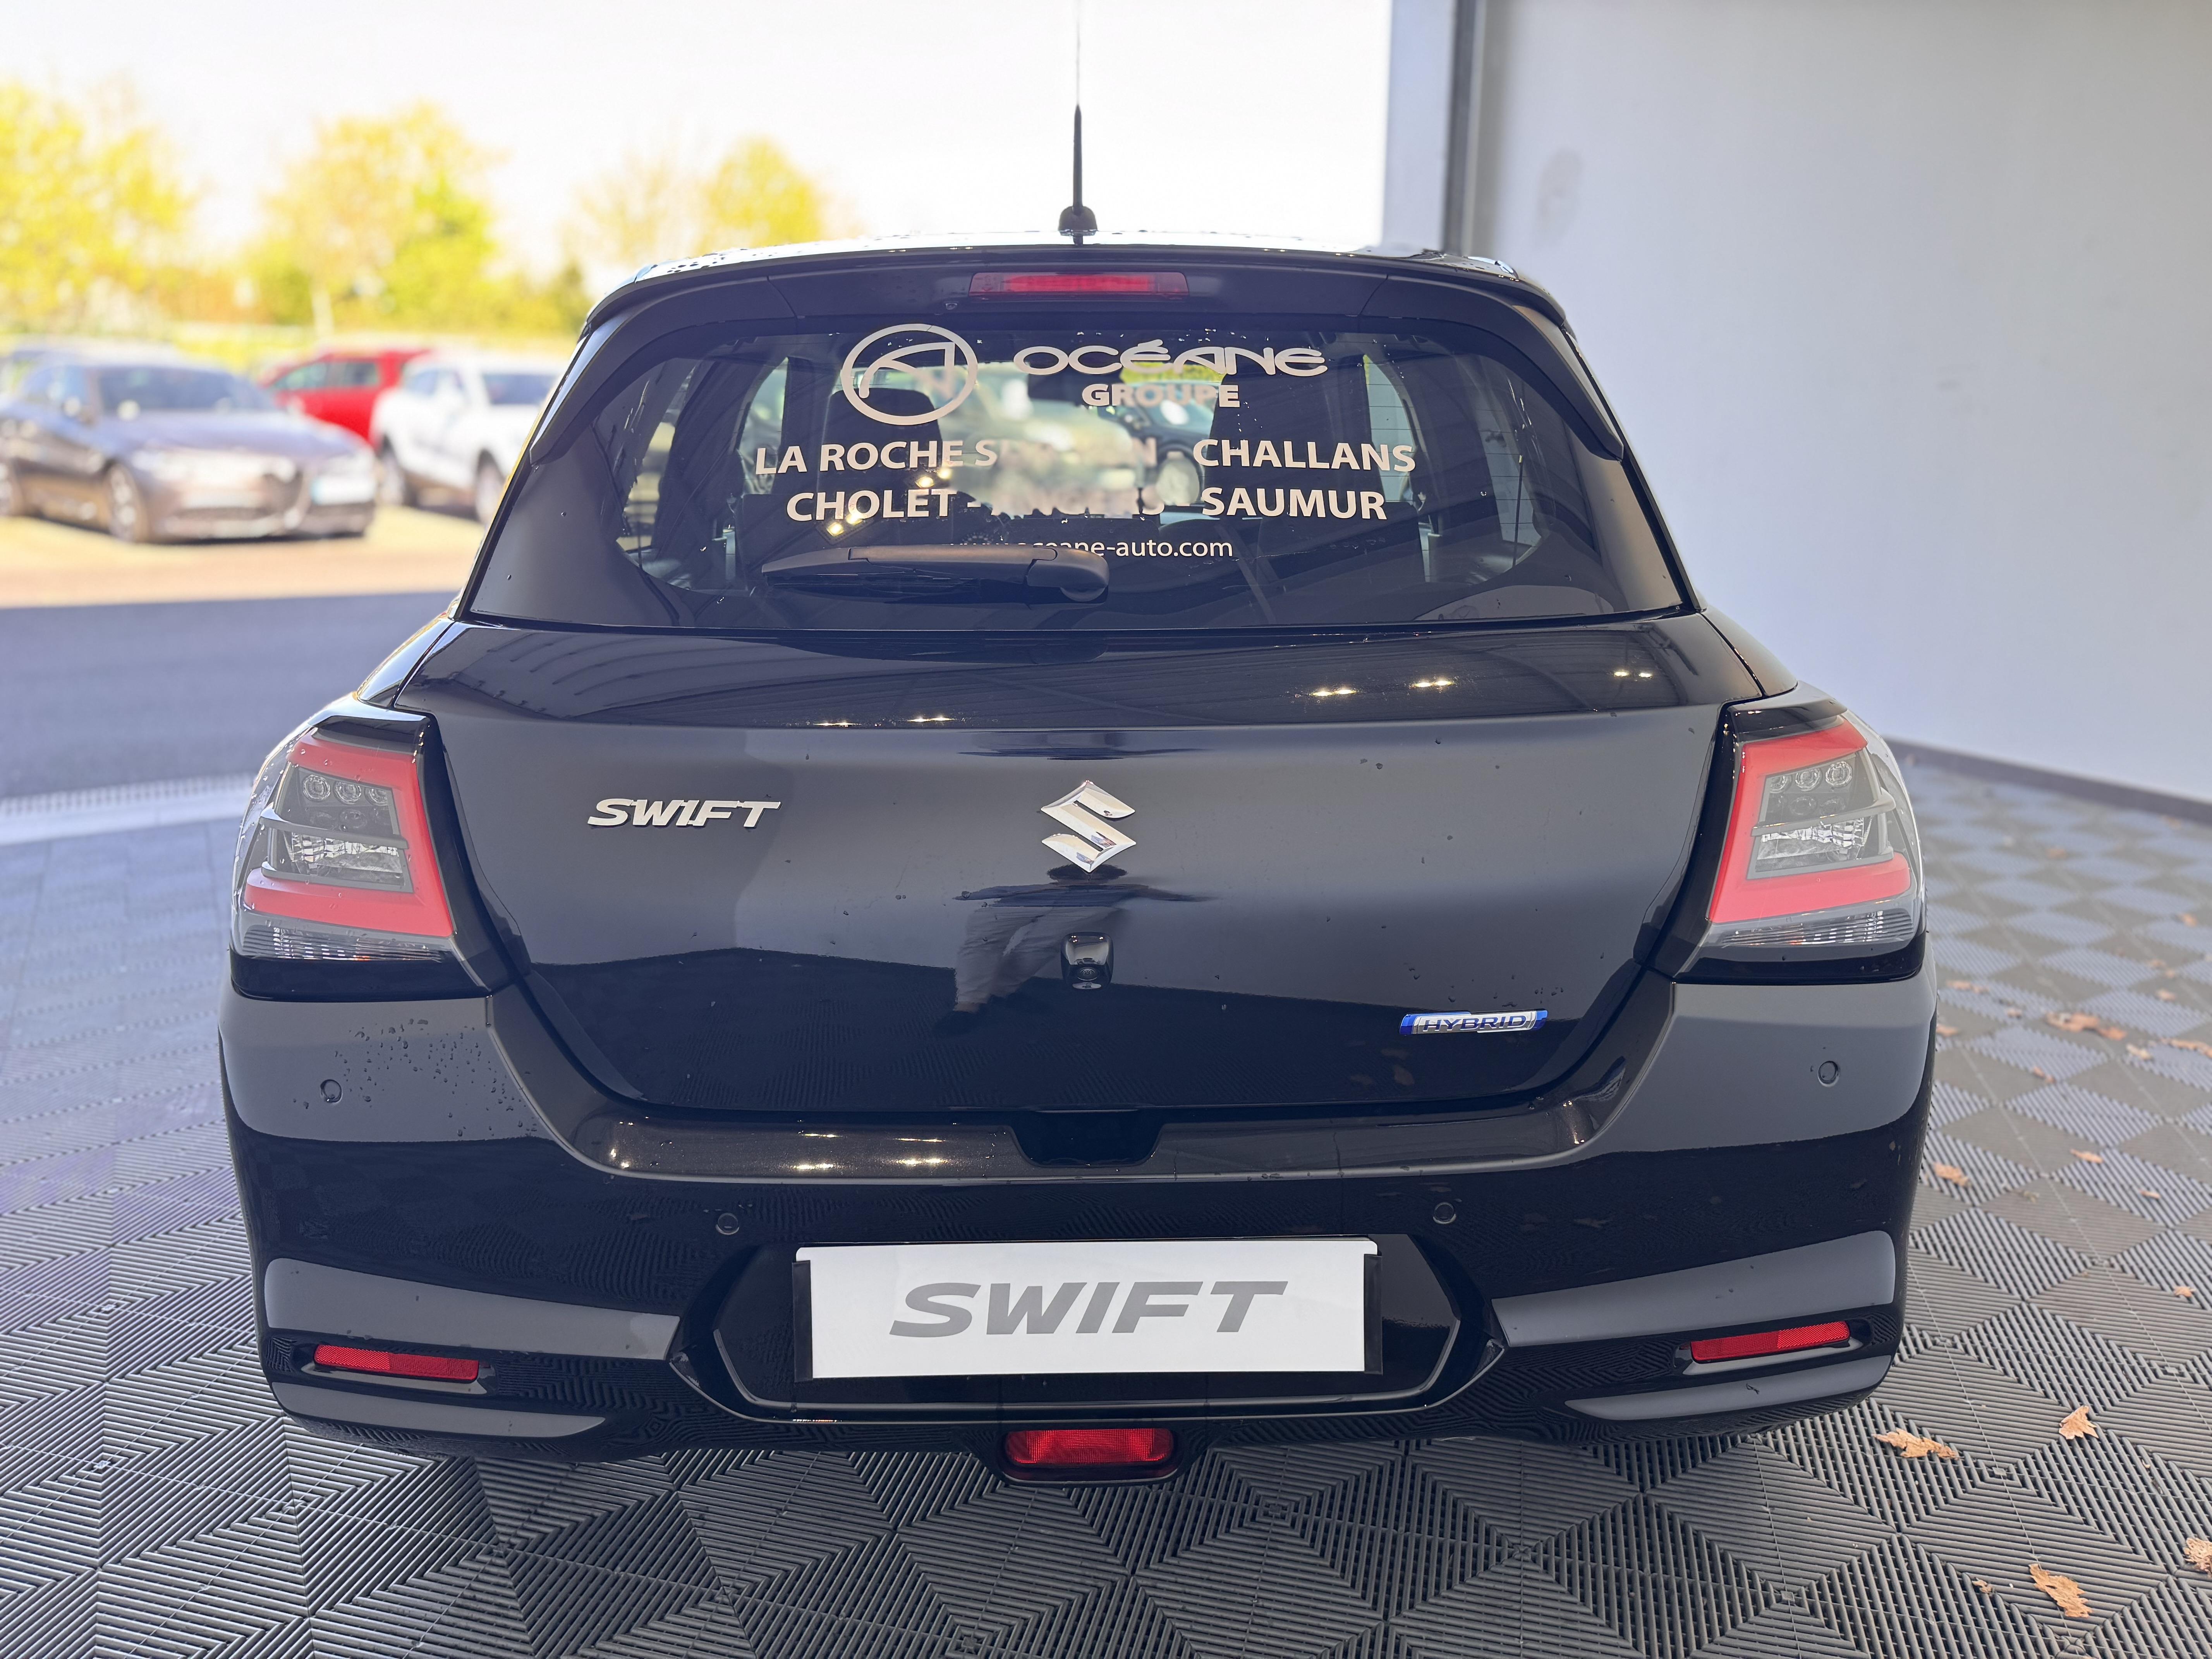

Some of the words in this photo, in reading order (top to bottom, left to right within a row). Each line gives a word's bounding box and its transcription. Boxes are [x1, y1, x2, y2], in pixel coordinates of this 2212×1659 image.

[1013, 339, 1328, 377] OCÉANE
[1082, 384, 1240, 407] GROUPE
[756, 446, 807, 475] LA
[820, 441, 963, 472] ROCHE
[1193, 439, 1415, 472] CHALLANS
[787, 488, 957, 521] CHOLET
[1202, 487, 1387, 520] SAUMUR
[587, 798, 781, 828] SWIFT
[1422, 1015, 1527, 1032] HYBRID
[889, 1281, 1288, 1338] SWIFT
